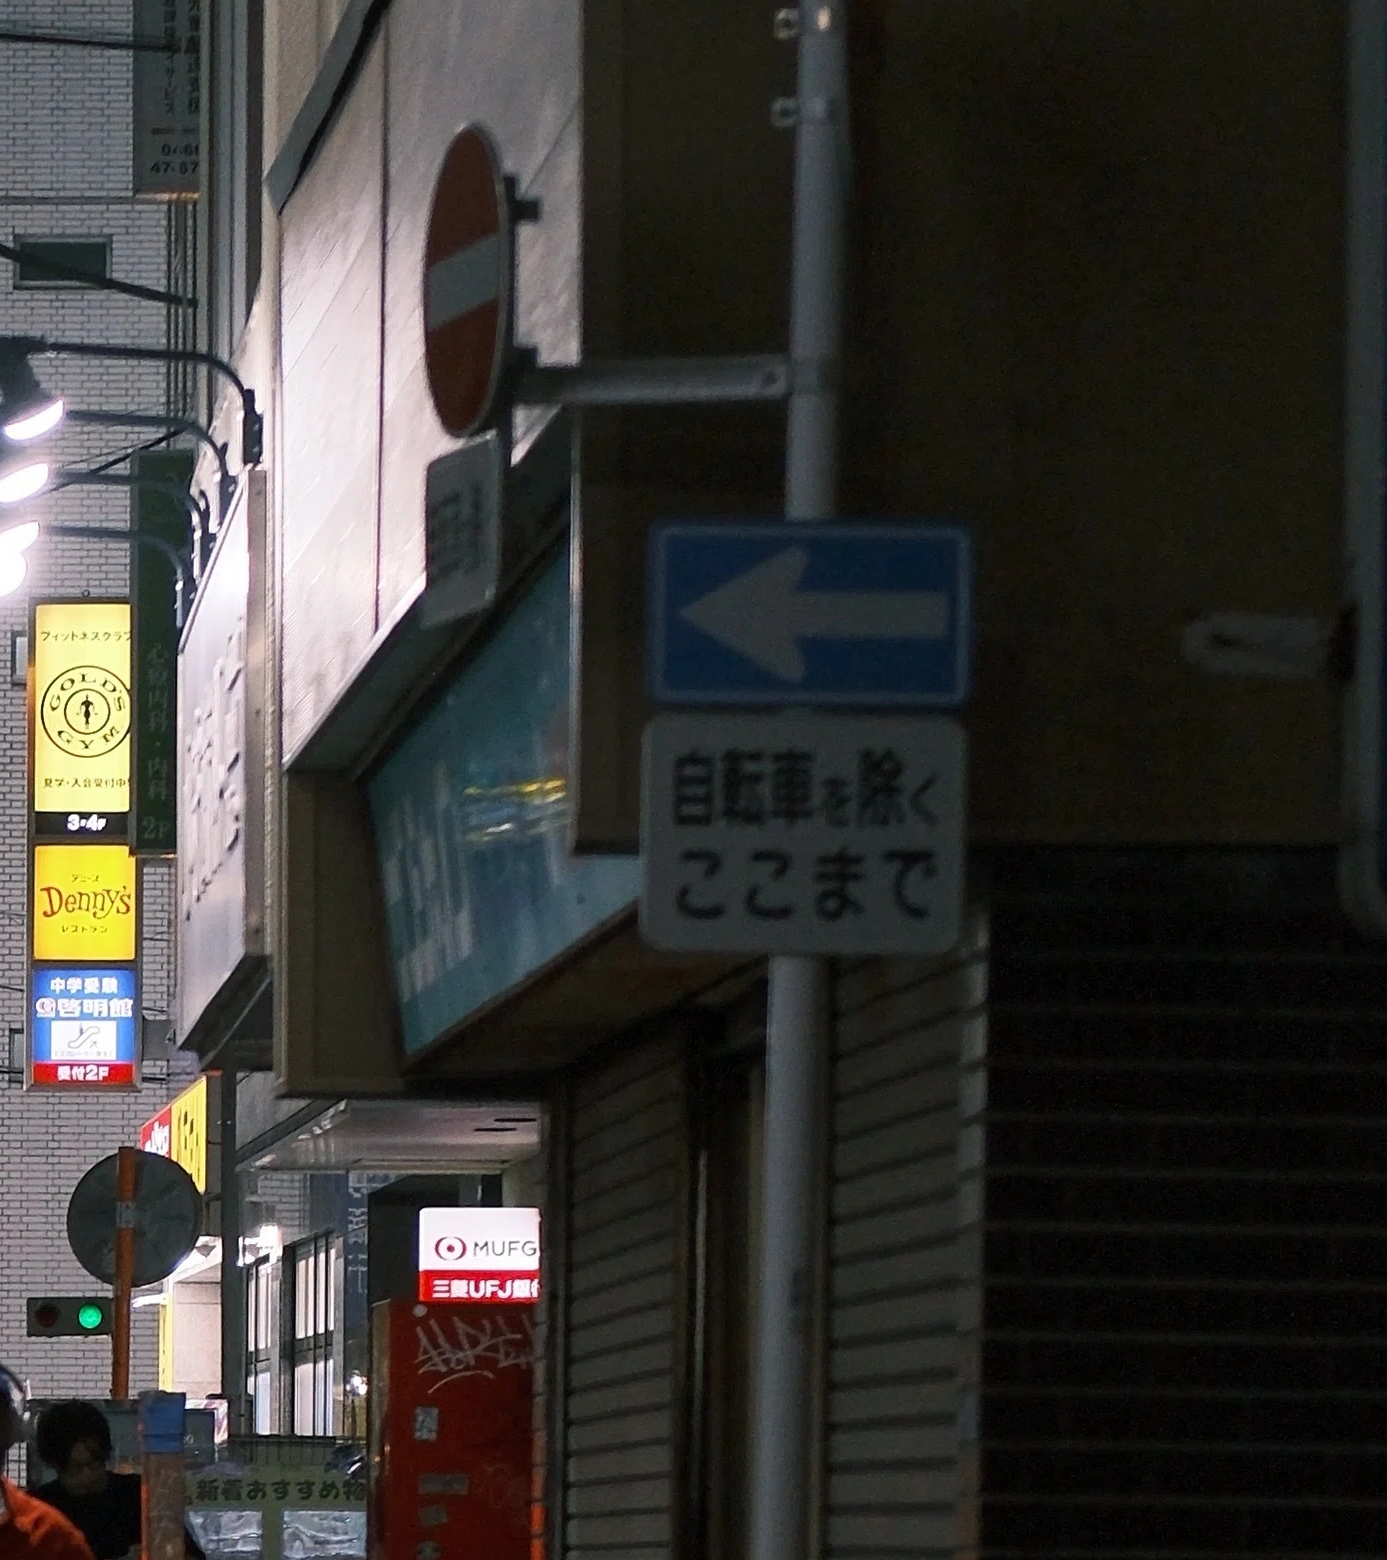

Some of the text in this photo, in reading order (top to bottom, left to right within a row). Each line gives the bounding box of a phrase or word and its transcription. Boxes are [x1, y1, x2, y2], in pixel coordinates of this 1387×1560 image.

[49, 672, 126, 712] GOLD'S
[57, 725, 121, 750] GYM
[673, 746, 938, 829] 自転車を除く
[142, 816, 171, 840] 2F
[677, 844, 938, 920] ここまで
[40, 885, 132, 920] Denny's
[61, 924, 109, 934] レストラン
[50, 976, 118, 994] 中学受験
[473, 1240, 538, 1257] MUFG
